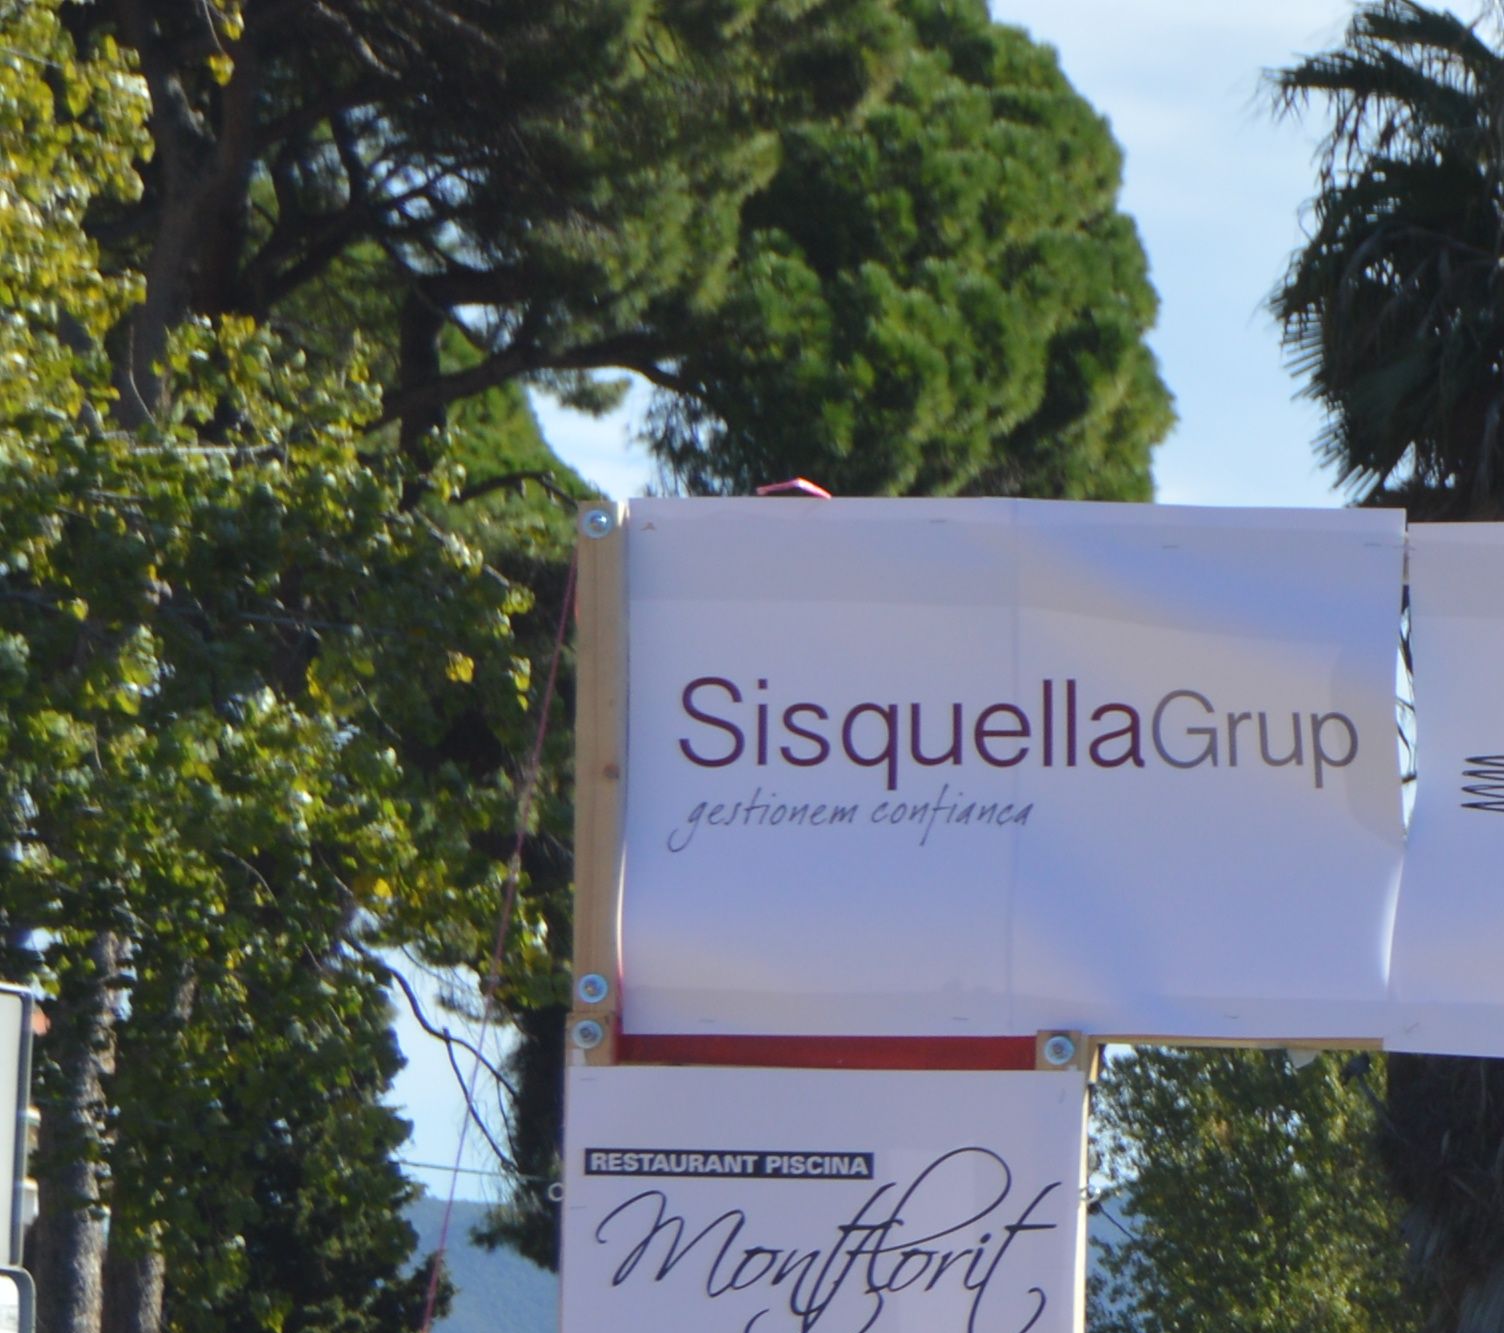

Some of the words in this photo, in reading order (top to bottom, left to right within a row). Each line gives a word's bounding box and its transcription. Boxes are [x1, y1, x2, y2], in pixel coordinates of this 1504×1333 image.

[677, 676, 1360, 790] SisquellaGrup
[667, 787, 859, 853] gestionem
[589, 1150, 759, 1174] RESTAURANT
[764, 1154, 869, 1176] PISCINA
